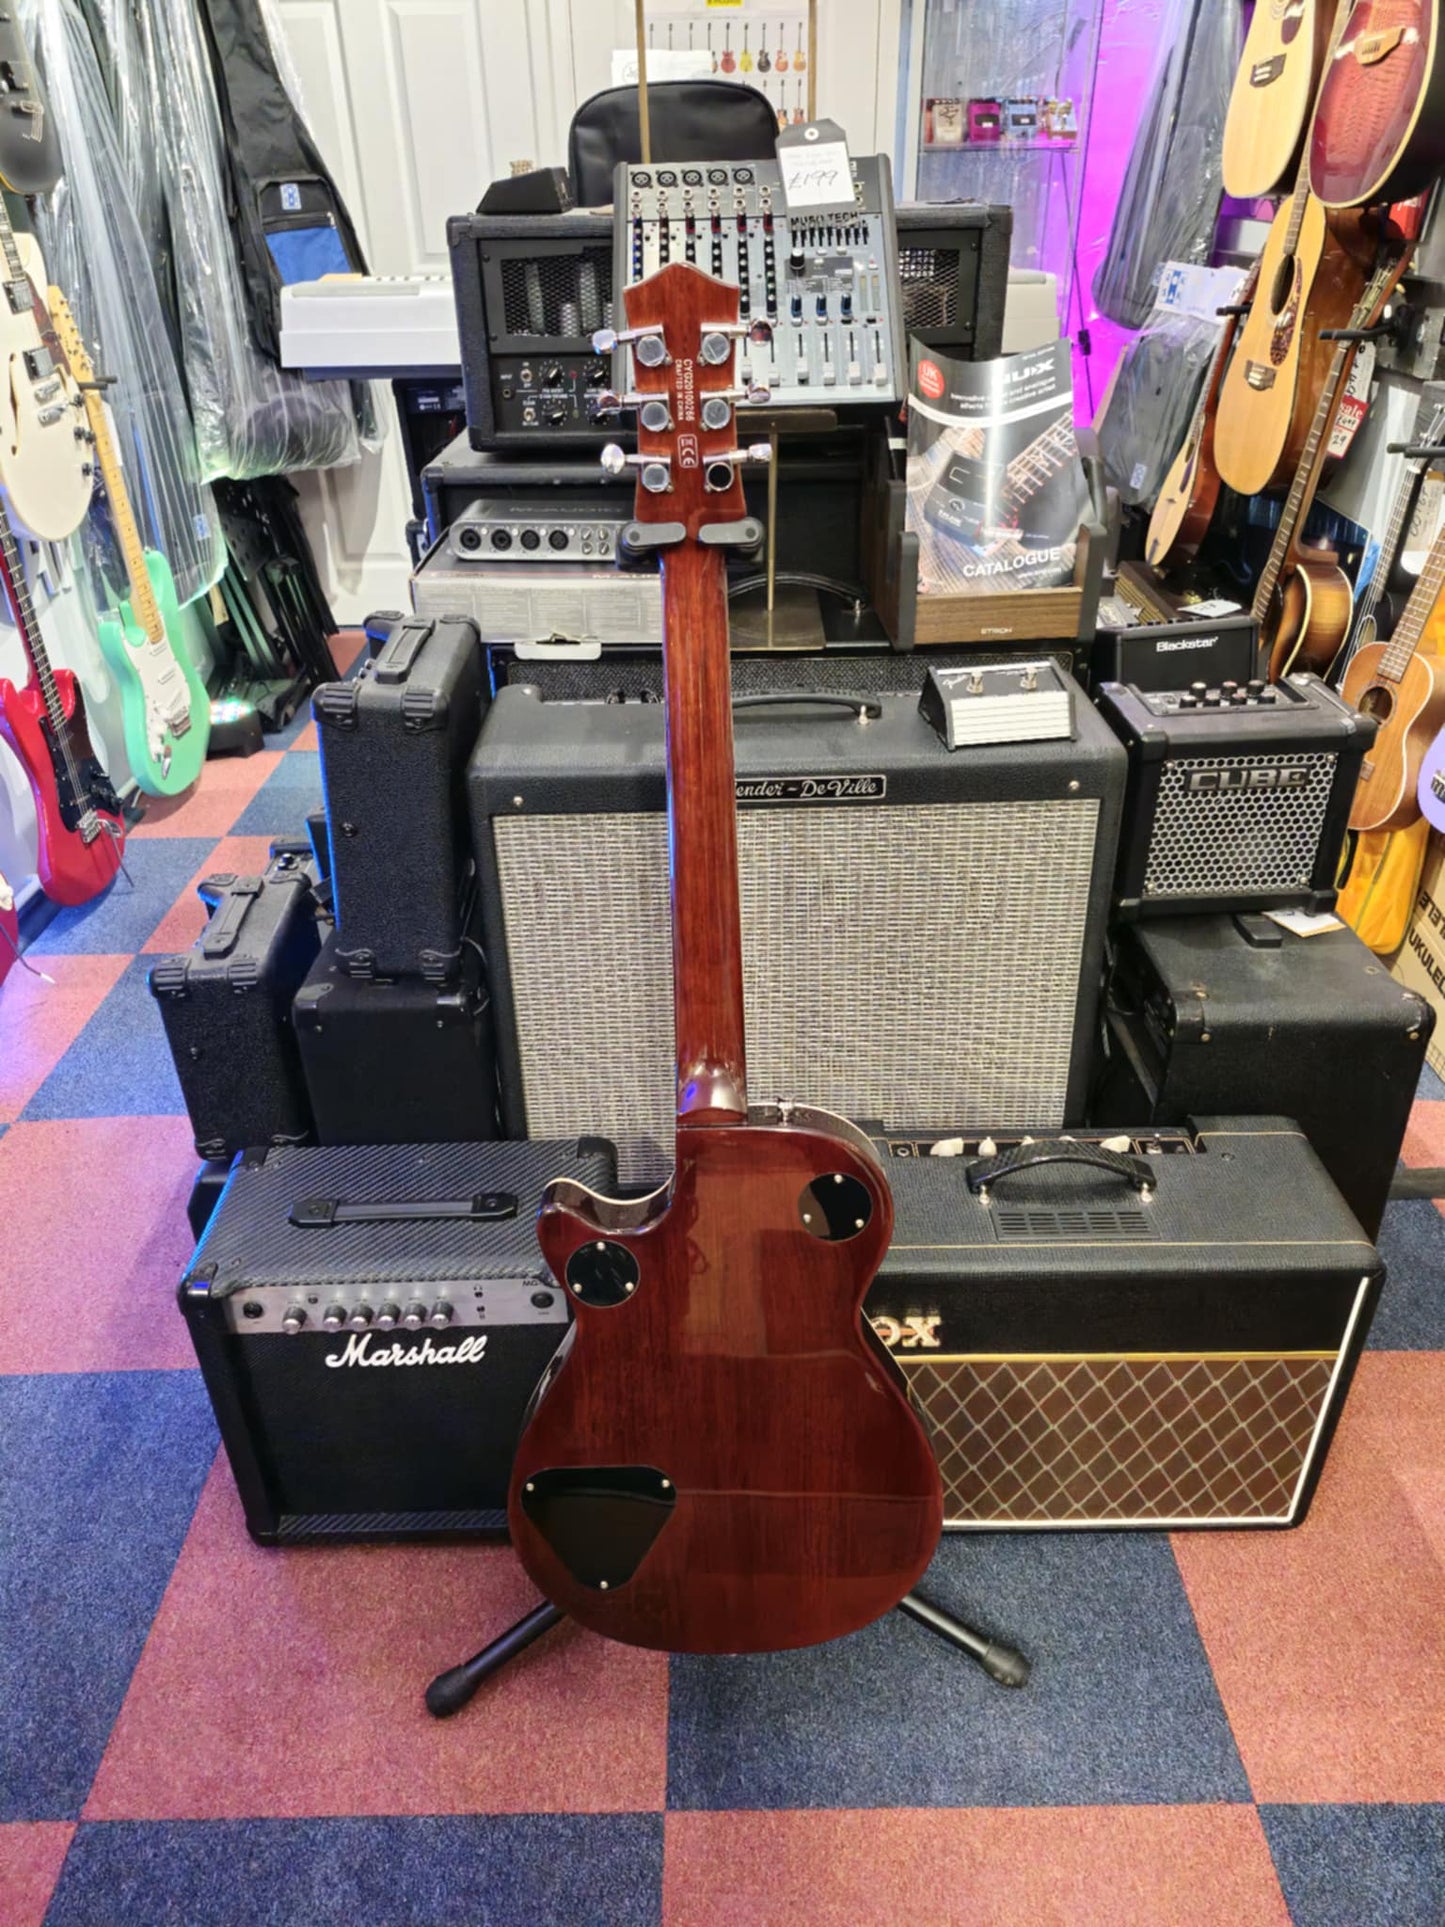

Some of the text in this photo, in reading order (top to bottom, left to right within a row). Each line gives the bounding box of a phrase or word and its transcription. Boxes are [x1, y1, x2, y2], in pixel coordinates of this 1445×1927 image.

[787, 169, 839, 191] £199
[827, 210, 859, 222] TECH
[963, 548, 1062, 578] CATALOGUE
[1156, 637, 1217, 652] Blackstar
[734, 780, 784, 798] ender
[1188, 768, 1308, 791] CUBE
[324, 1332, 488, 1369] Marshall
